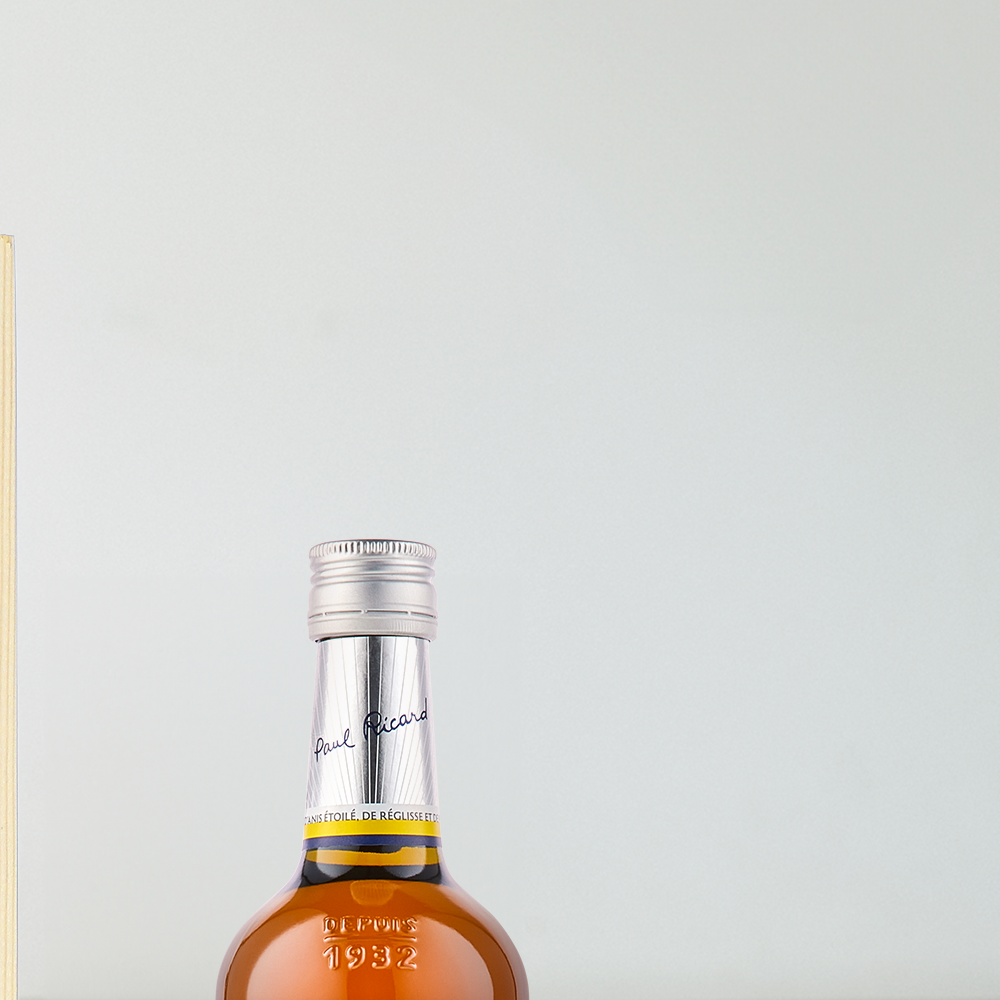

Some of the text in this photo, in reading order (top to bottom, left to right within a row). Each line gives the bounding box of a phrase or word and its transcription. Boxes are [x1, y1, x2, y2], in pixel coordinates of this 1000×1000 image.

[314, 697, 428, 762] Paul Ricard
[323, 809, 360, 822] ÉTOILÉ,
[362, 811, 377, 821] DE
[379, 808, 424, 822] RÉGLISSE
[424, 812, 432, 822] ET
[322, 914, 418, 933] DEPUIS
[321, 944, 418, 970] 1932
